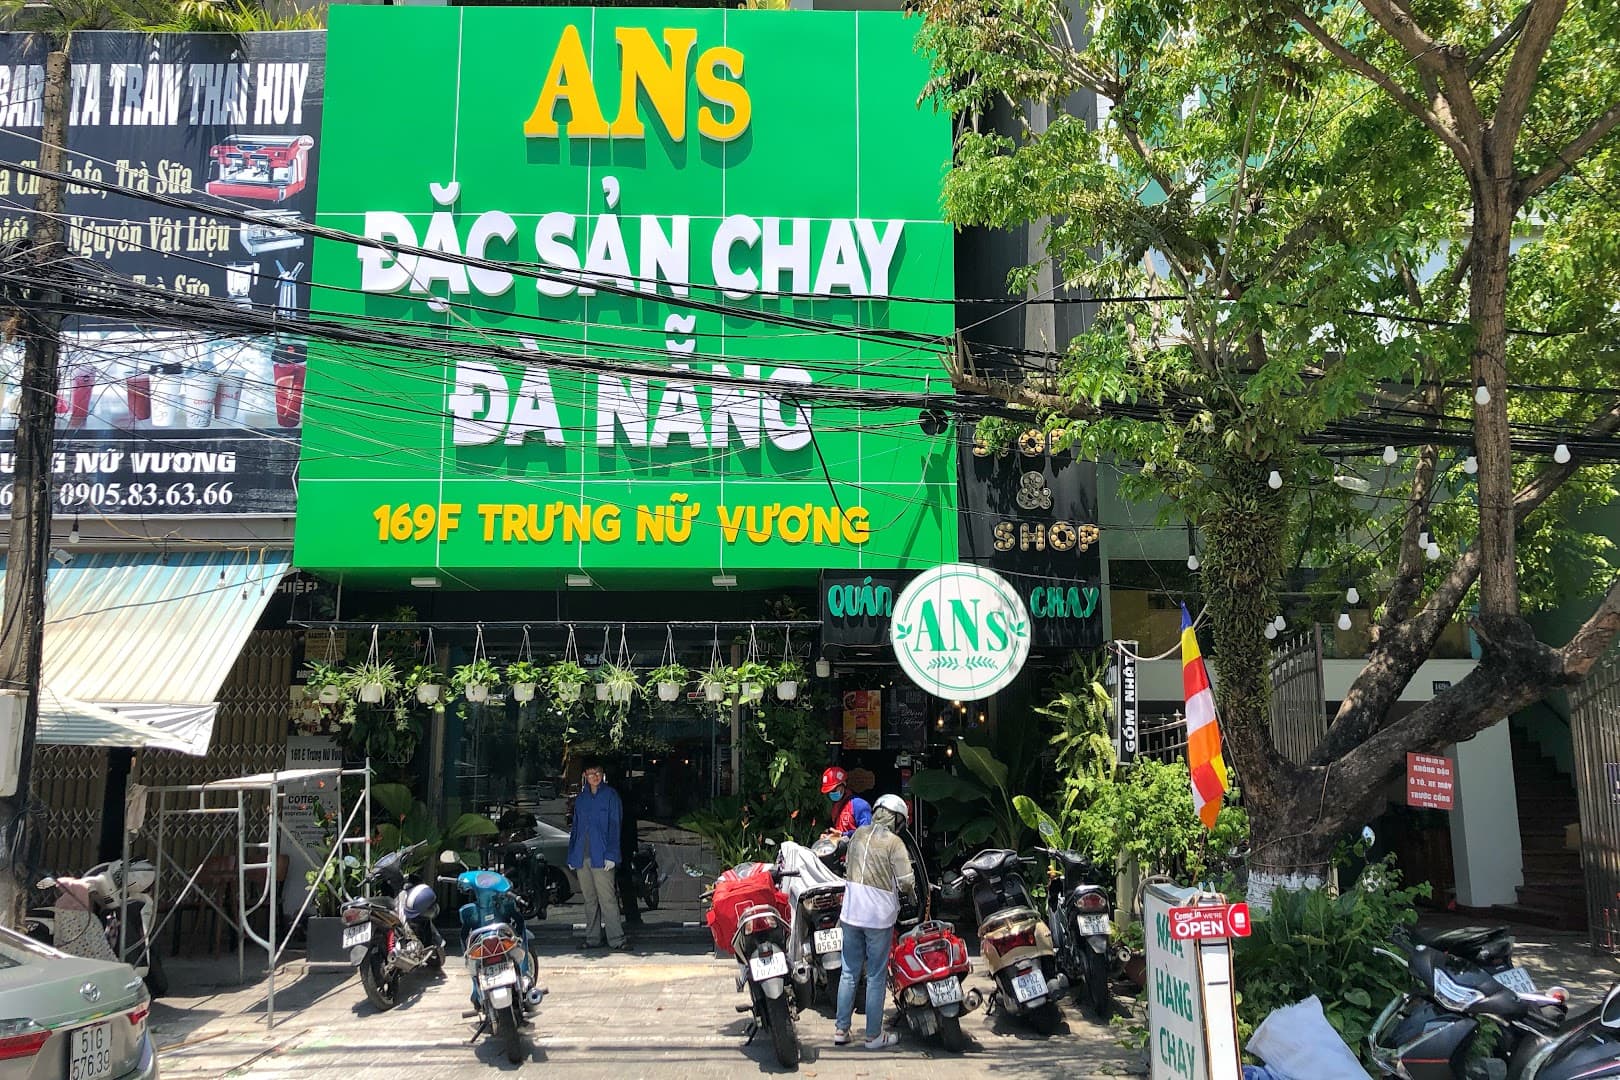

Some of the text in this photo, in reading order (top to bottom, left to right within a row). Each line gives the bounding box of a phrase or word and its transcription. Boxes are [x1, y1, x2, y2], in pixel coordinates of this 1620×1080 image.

[254, 63, 309, 125] HUY
[156, 160, 193, 194] Sữa
[67, 216, 142, 259] Nguyên
[149, 216, 180, 257] Vật
[186, 216, 230, 257] Liệu
[357, 175, 906, 313] ĐẶC SẢN CHAY
[448, 313, 815, 452] ĐÀ NẴNG
[75, 448, 124, 473] NỮ
[130, 451, 237, 474] VƯƠNG
[60, 481, 234, 506] 0905.83.63.66
[1016, 470, 1051, 509] &
[373, 492, 870, 545] 169F TRƯNG NỮ VƯƠNG
[993, 521, 1100, 552] SHOP
[828, 576, 1099, 618] QUÁN CHAY
[1176, 920, 1224, 937] OPEN
[1156, 964, 1194, 1022] HÀNG
[82, 1028, 102, 1053] 51G
[1159, 1026, 1195, 1079] CHAY
